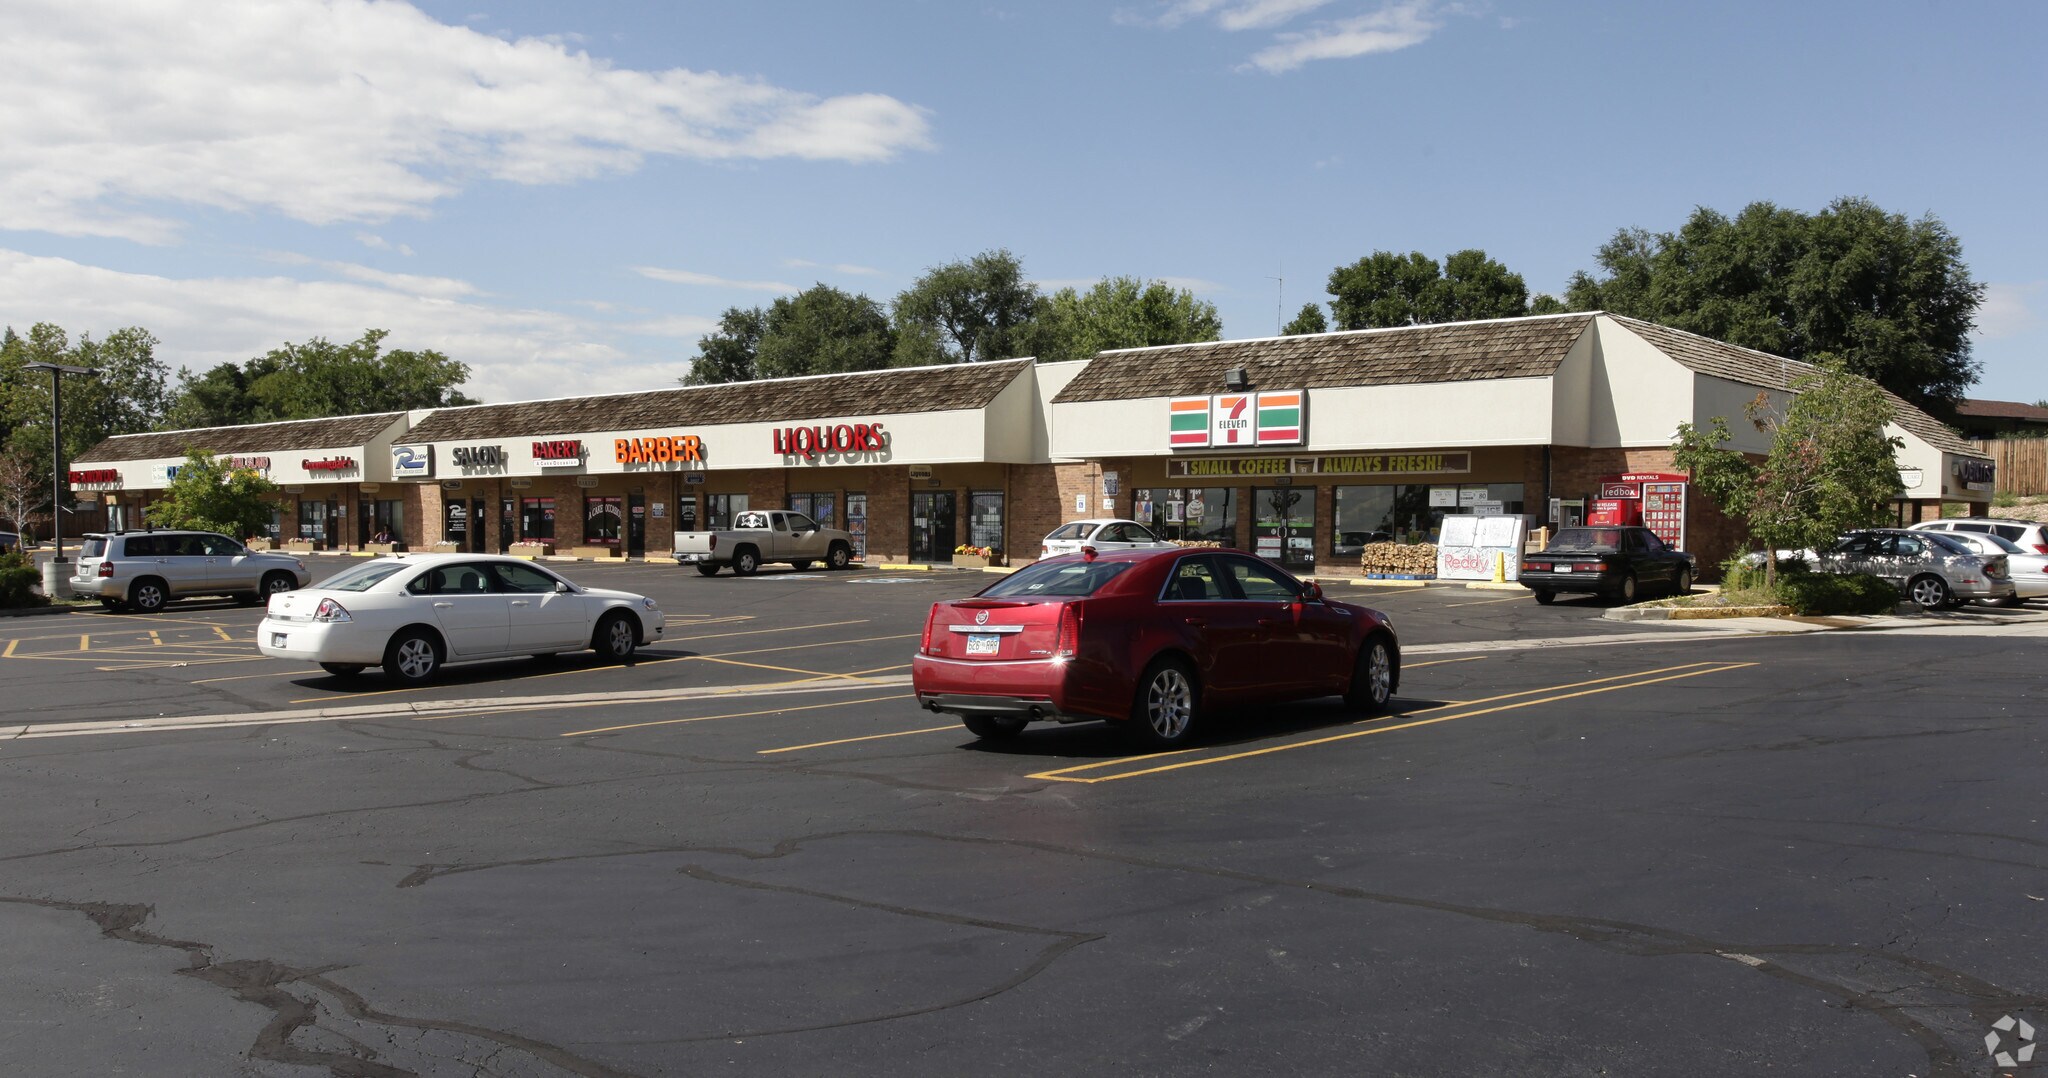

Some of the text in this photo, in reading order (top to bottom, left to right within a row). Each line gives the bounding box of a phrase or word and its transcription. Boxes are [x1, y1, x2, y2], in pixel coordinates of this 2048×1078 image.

[532, 440, 582, 458] BAKERY
[615, 435, 702, 463] BARBER
[773, 423, 885, 460] LIQUORS
[452, 445, 502, 466] SALON
[1322, 455, 1443, 474] ALWAYS FRESH!
[82, 469, 103, 483] KWON
[103, 468, 118, 482] DO
[1180, 459, 1286, 475] $1 SMALL COFFEE
[1958, 459, 1995, 483] DENTIST
[1605, 488, 1635, 497] redbox
[592, 504, 604, 517] CAKE
[1444, 553, 1490, 574] Reddy
[968, 640, 980, 651] 626
